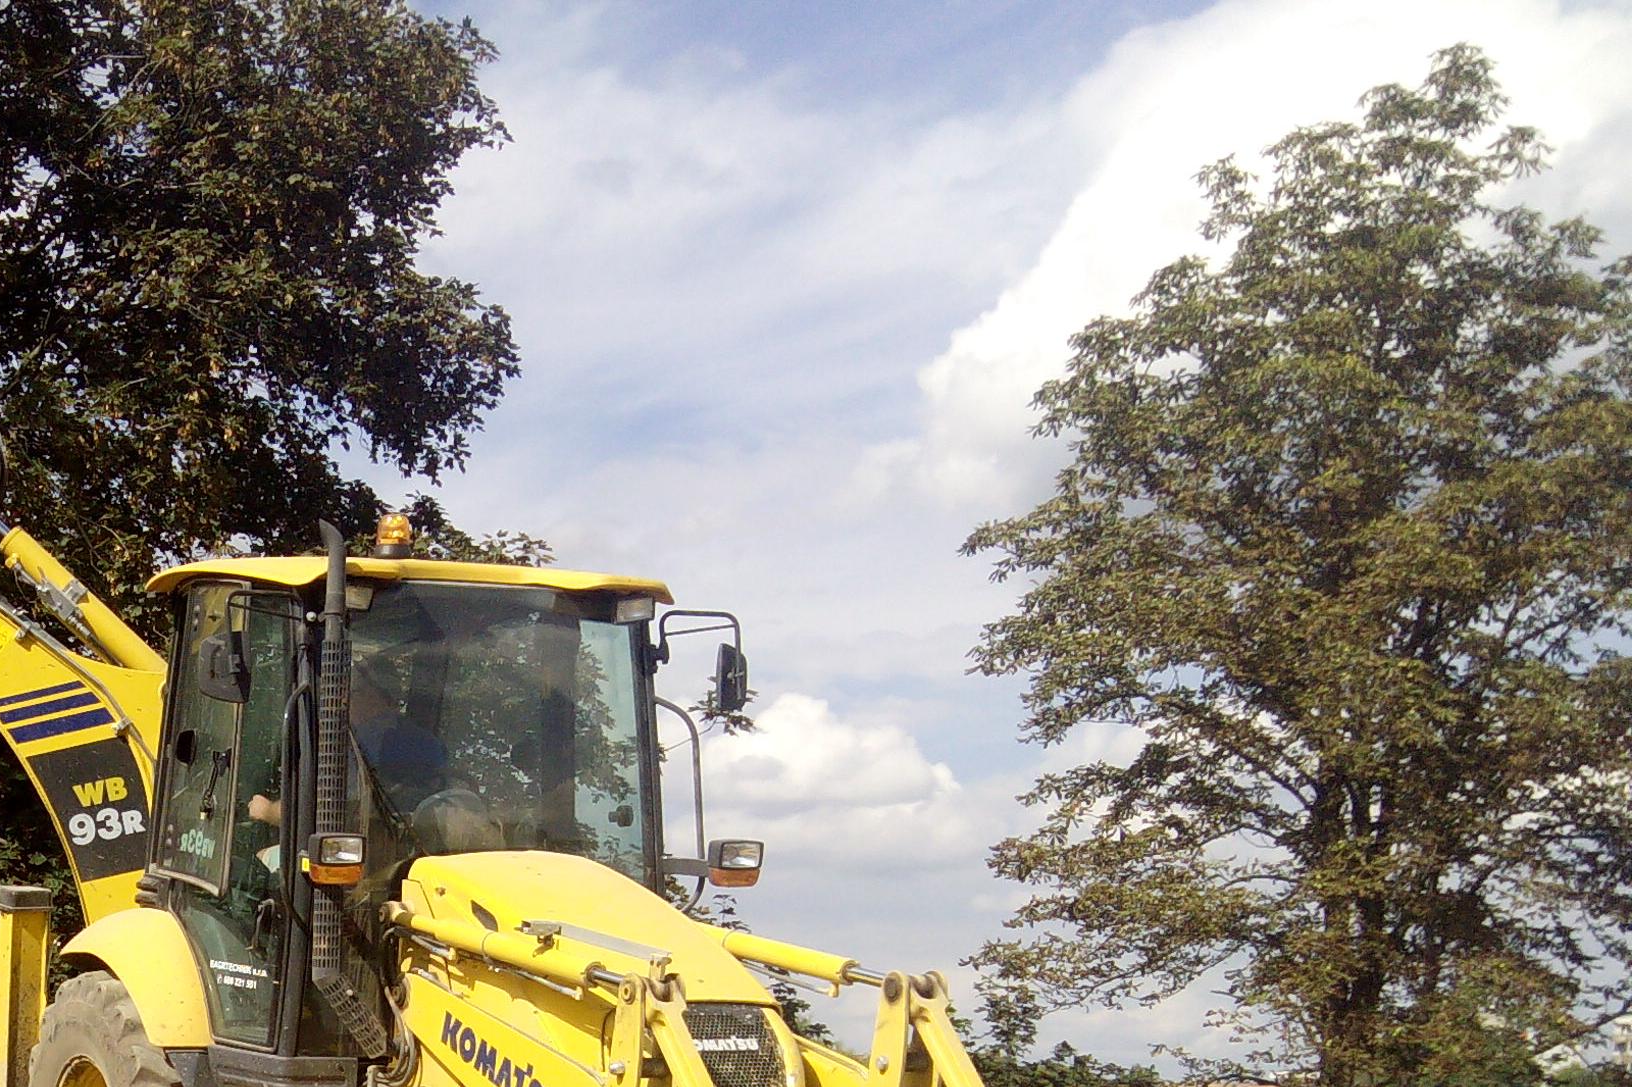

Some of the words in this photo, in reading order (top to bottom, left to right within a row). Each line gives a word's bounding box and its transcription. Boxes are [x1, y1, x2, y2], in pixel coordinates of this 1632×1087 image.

[72, 776, 128, 808] WB
[69, 807, 146, 846] 93R
[692, 1035, 759, 1051] OMATSU
